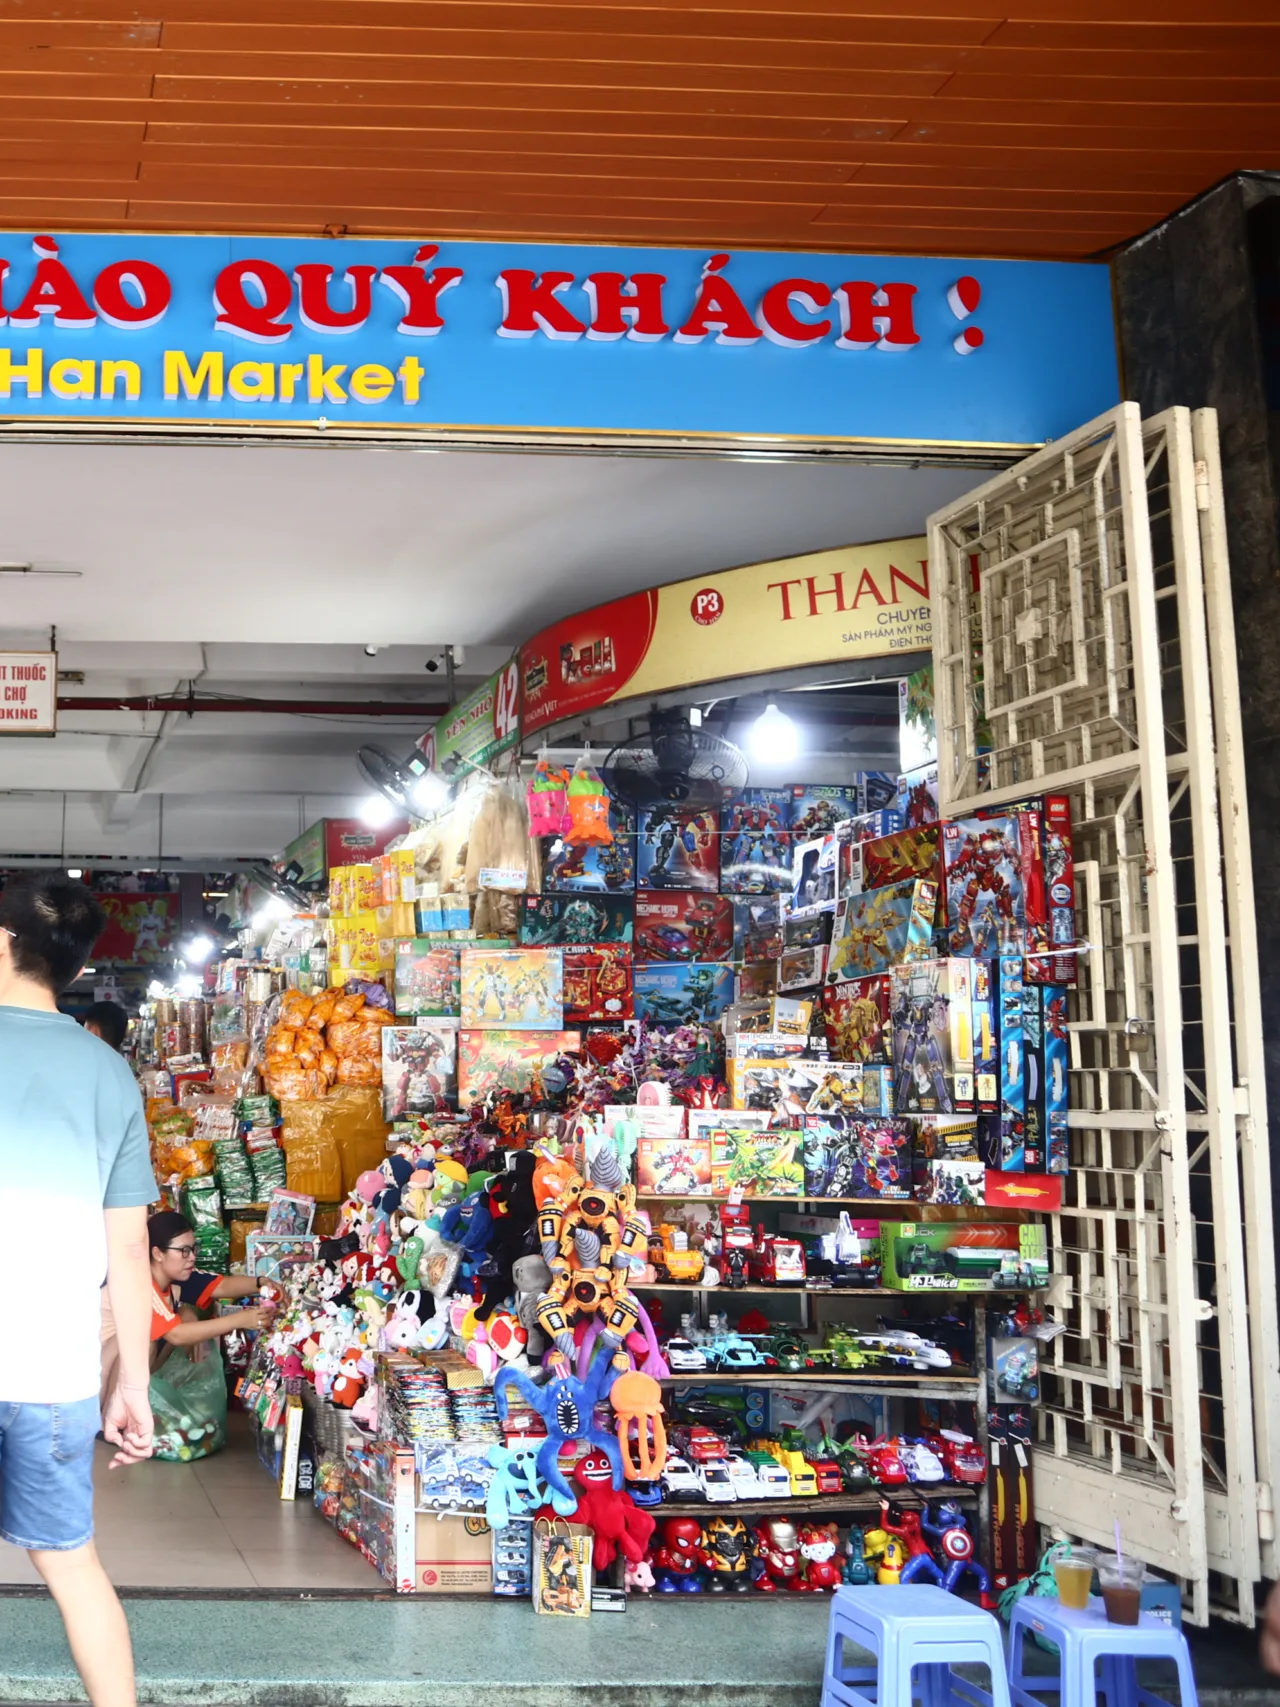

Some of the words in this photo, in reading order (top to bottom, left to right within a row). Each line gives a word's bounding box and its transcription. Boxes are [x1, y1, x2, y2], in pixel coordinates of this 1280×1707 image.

[214, 244, 465, 344] QUÝ
[496, 253, 922, 352] KHÁCH
[162, 350, 426, 405] Market
[696, 591, 719, 615] P3
[11, 662, 47, 681] THUỐC
[4, 684, 27, 705] CHỢ
[495, 661, 519, 737] 42
